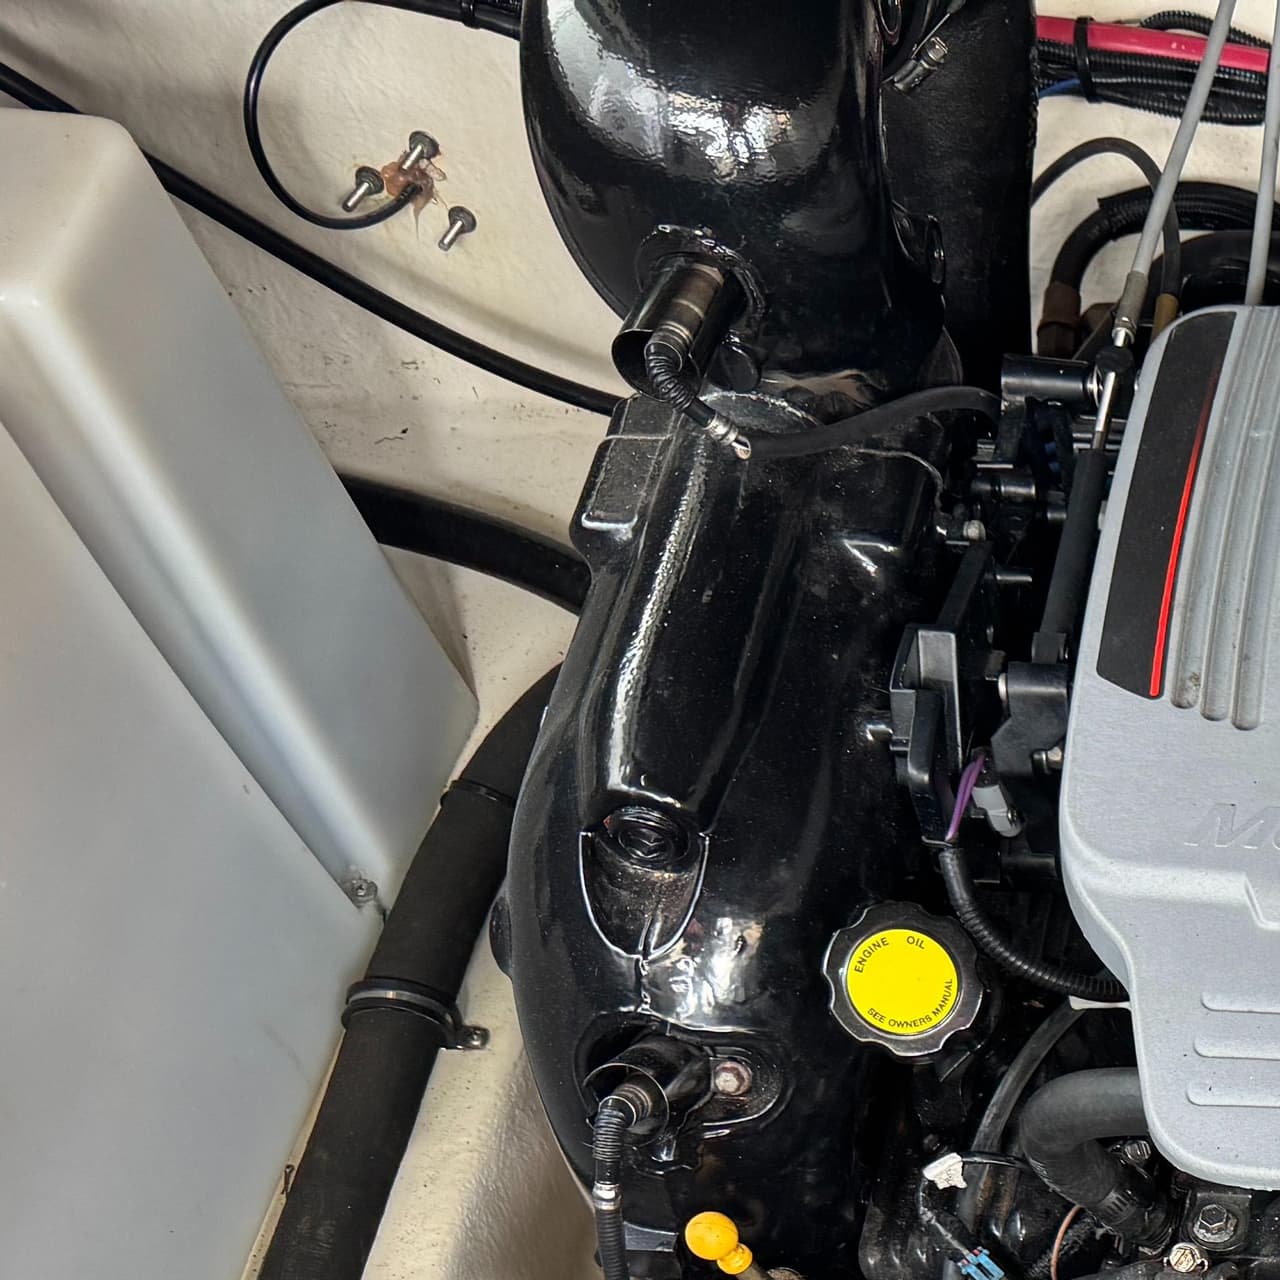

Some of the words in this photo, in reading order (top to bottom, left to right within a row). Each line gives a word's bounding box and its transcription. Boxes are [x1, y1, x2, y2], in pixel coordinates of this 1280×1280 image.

[854, 937, 889, 973] ENGINE
[906, 935, 925, 950] OIL
[867, 1007, 887, 1024] SEE
[888, 1014, 933, 1028] OWNERS
[933, 978, 953, 1018] MANUAL
